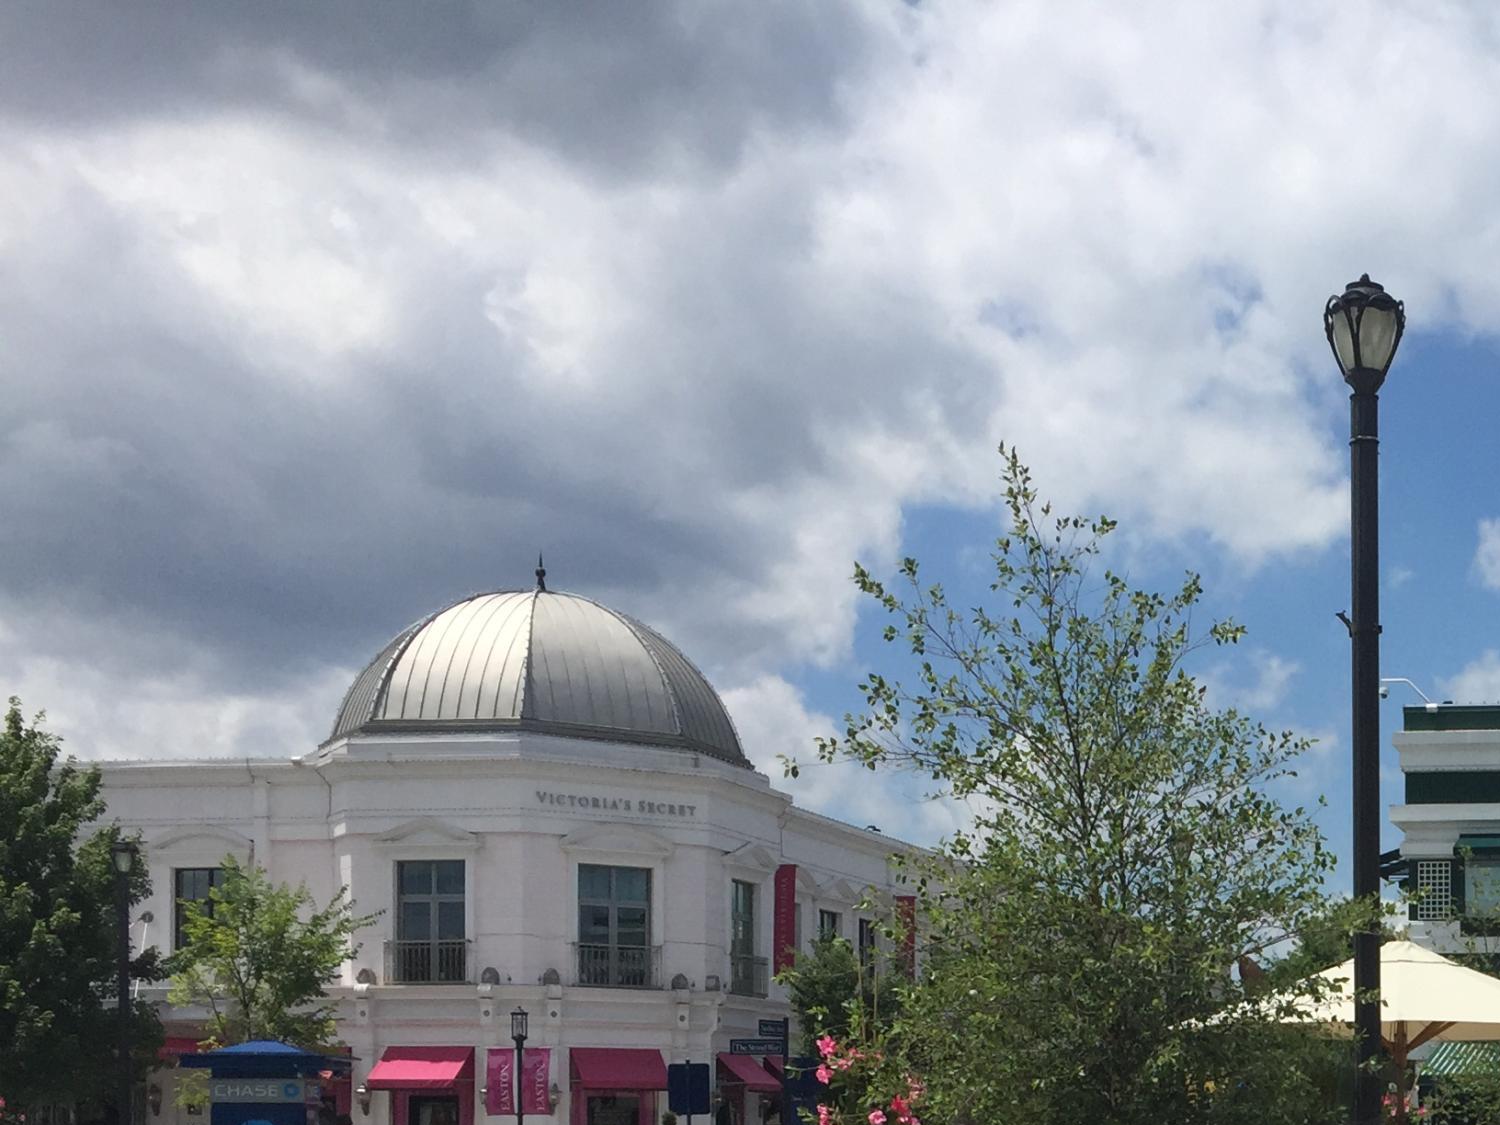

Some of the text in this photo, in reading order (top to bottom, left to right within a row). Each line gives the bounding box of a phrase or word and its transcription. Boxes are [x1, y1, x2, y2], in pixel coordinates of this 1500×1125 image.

[637, 800, 697, 817] SECRET
[214, 1084, 279, 1097] CHASE
[500, 1063, 510, 1111] EASTON
[535, 1063, 546, 1111] EASTON
